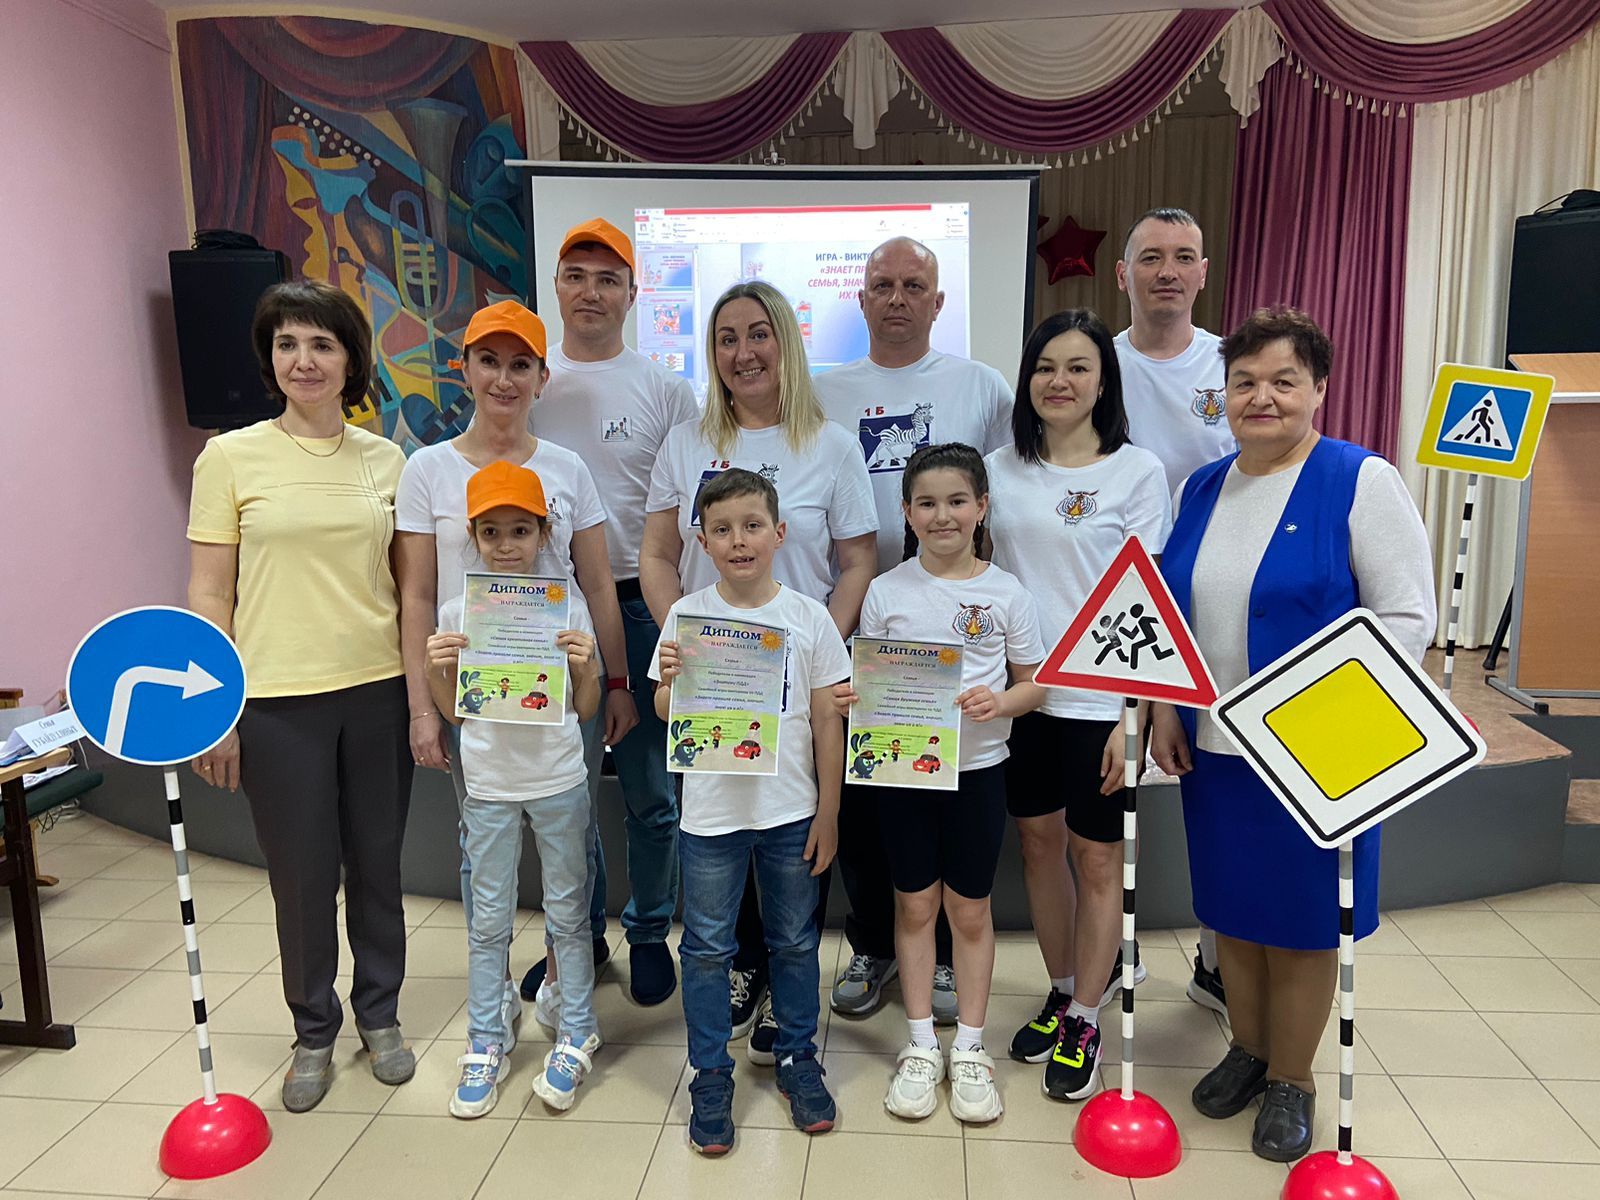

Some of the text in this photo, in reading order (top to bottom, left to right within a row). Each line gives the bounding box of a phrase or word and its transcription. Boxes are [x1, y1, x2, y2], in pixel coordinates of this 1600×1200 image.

[815, 253, 838, 262] ИГРА
[820, 265, 853, 274] «ЗНАЕТ
[808, 278, 840, 288] СЕМЬЯ,
[838, 291, 852, 300] ИХ
[710, 642, 758, 650] НАГРАЖДАЕТСЯ
